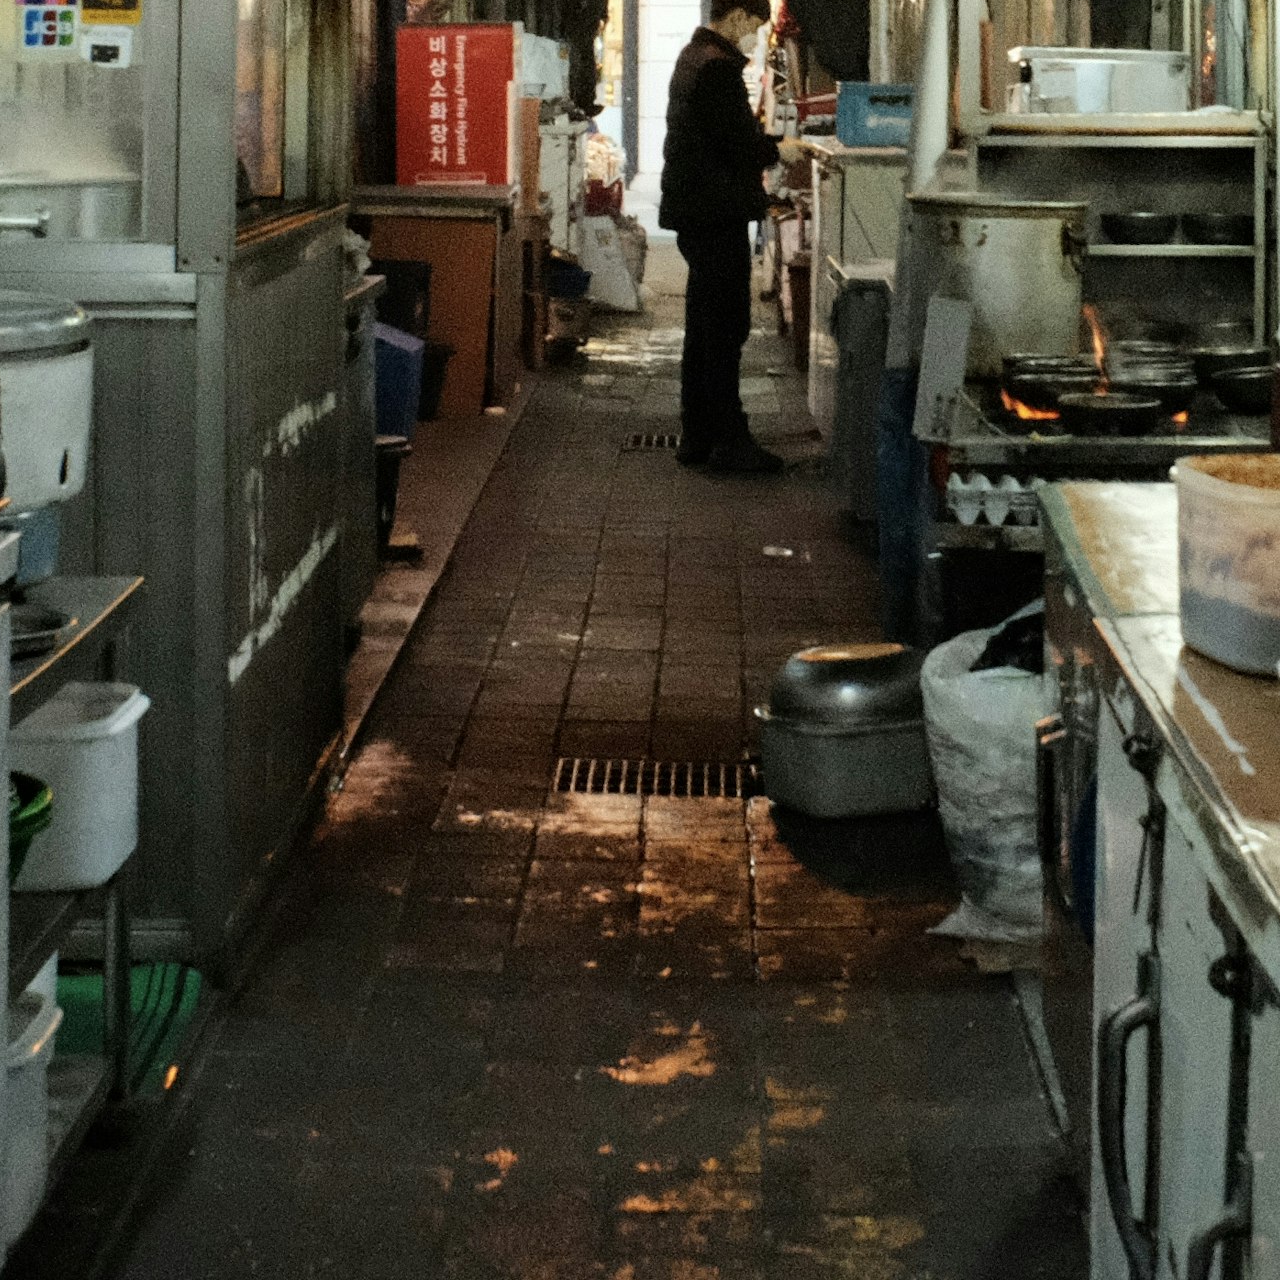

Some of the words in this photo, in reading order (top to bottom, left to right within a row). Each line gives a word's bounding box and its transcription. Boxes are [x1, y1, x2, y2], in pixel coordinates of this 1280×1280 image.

[454, 35, 467, 96] Emergency
[428, 35, 449, 166] 비상소화장치
[456, 97, 468, 119] Fire
